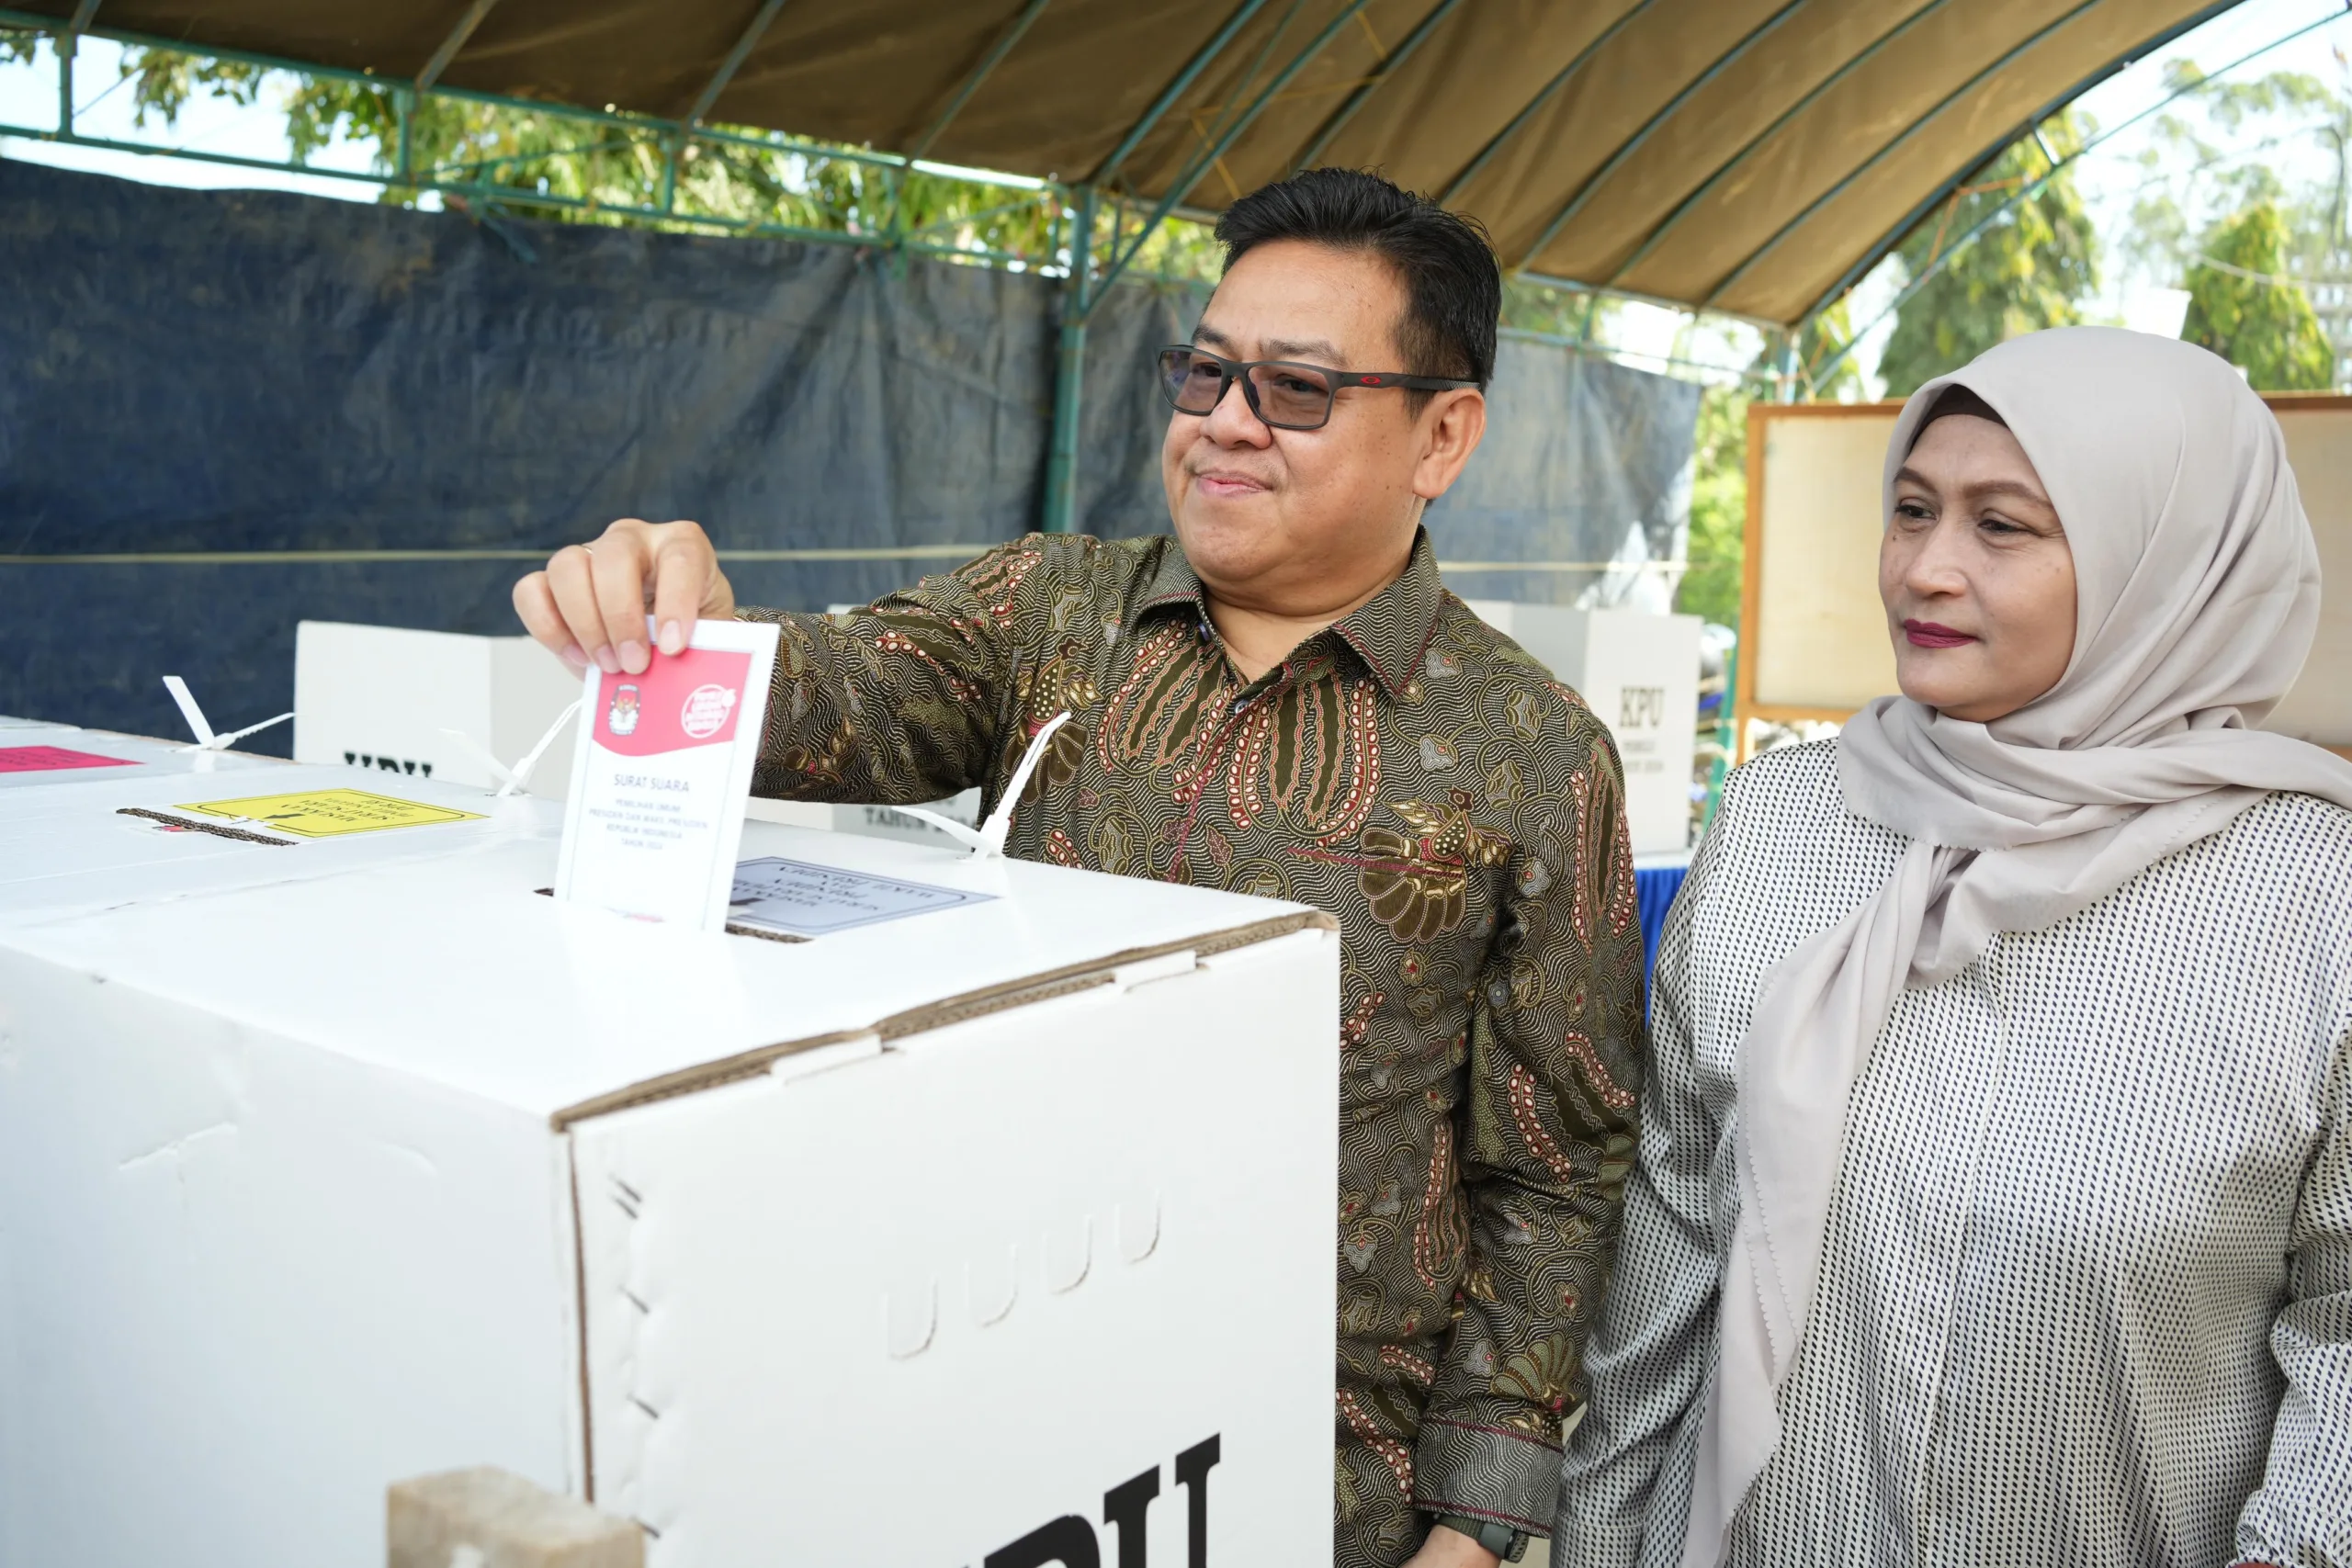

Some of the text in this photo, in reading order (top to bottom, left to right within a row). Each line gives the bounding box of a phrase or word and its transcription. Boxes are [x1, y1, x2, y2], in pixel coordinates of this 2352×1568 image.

[1620, 686, 1666, 728] KPU
[614, 773, 689, 792] SURAT SUARA
